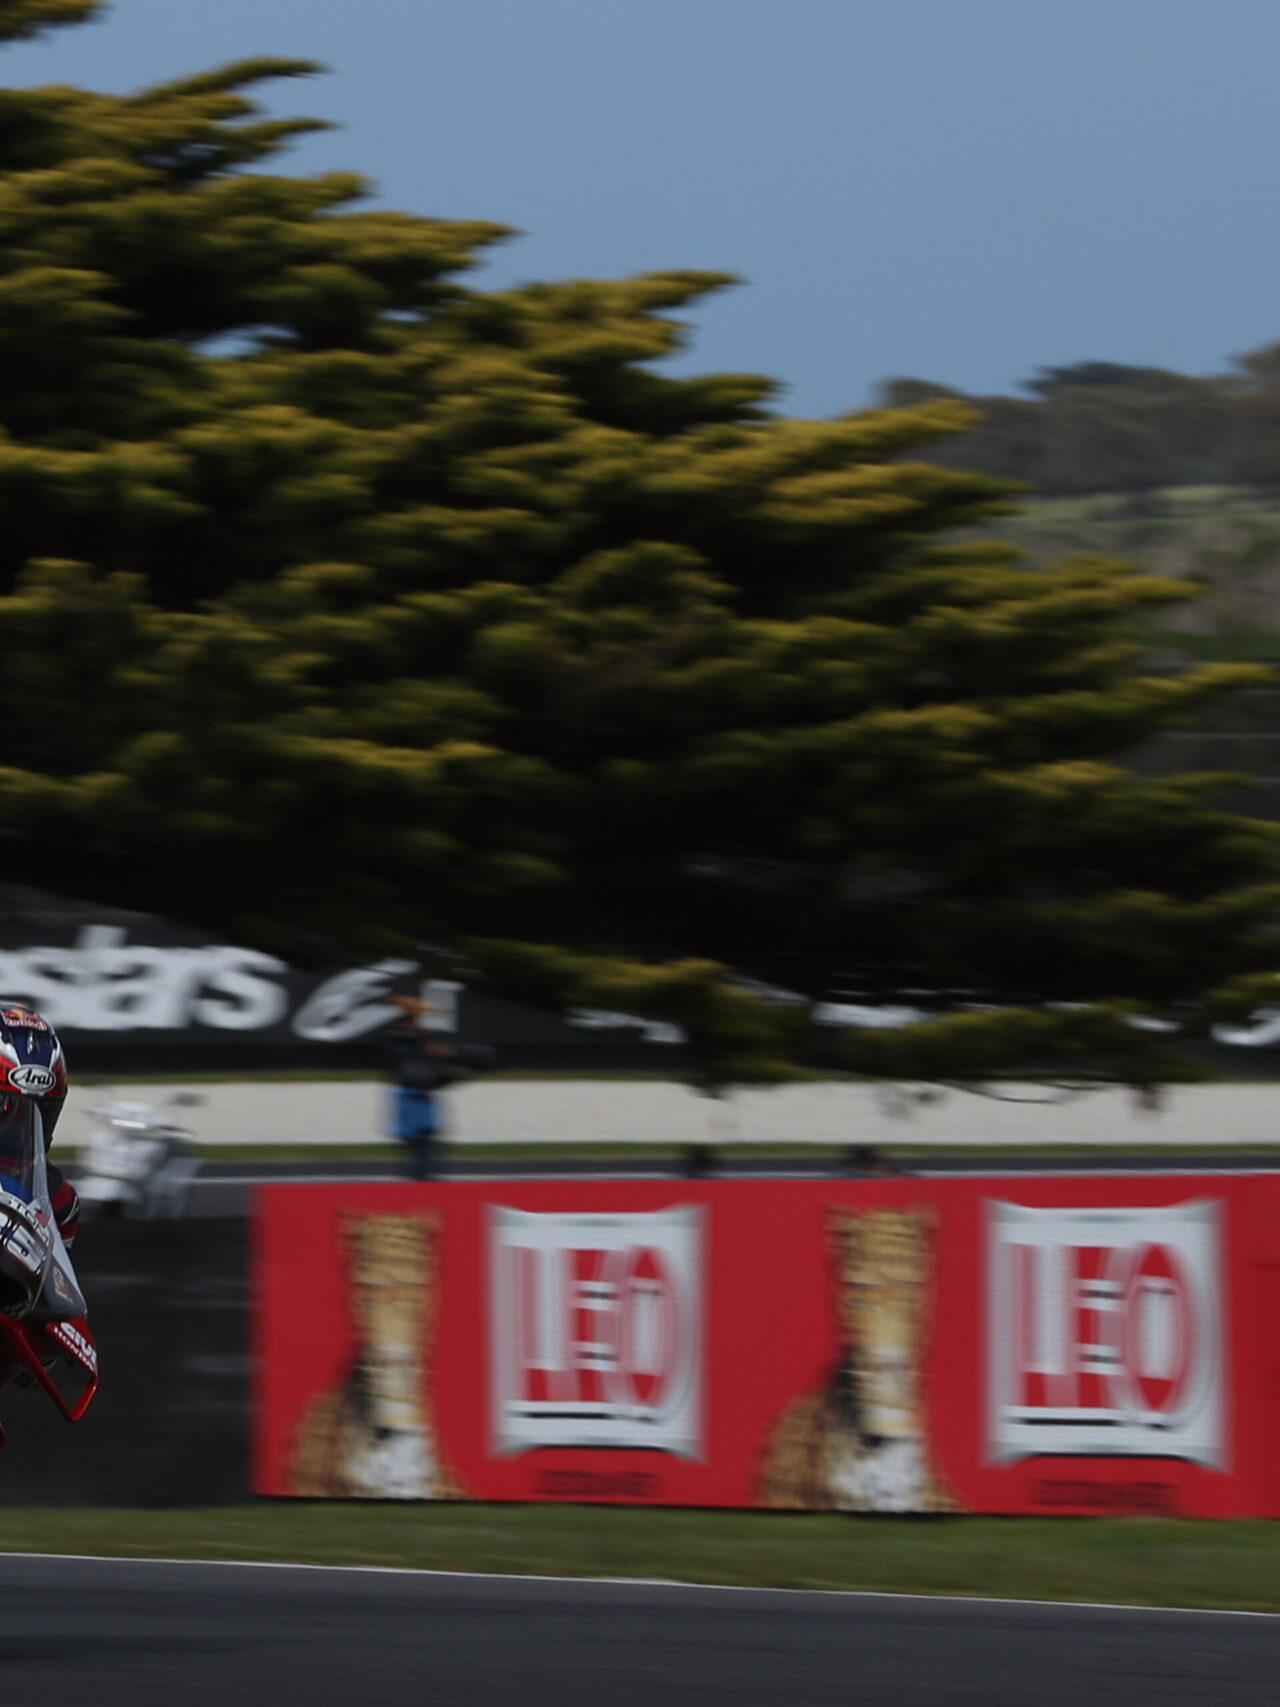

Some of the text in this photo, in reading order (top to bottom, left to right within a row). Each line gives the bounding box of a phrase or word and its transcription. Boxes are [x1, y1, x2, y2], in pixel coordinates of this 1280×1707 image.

[12, 1069, 50, 1086] Arai
[53, 1326, 95, 1371] HONDA
[60, 1321, 98, 1364] GIVI
